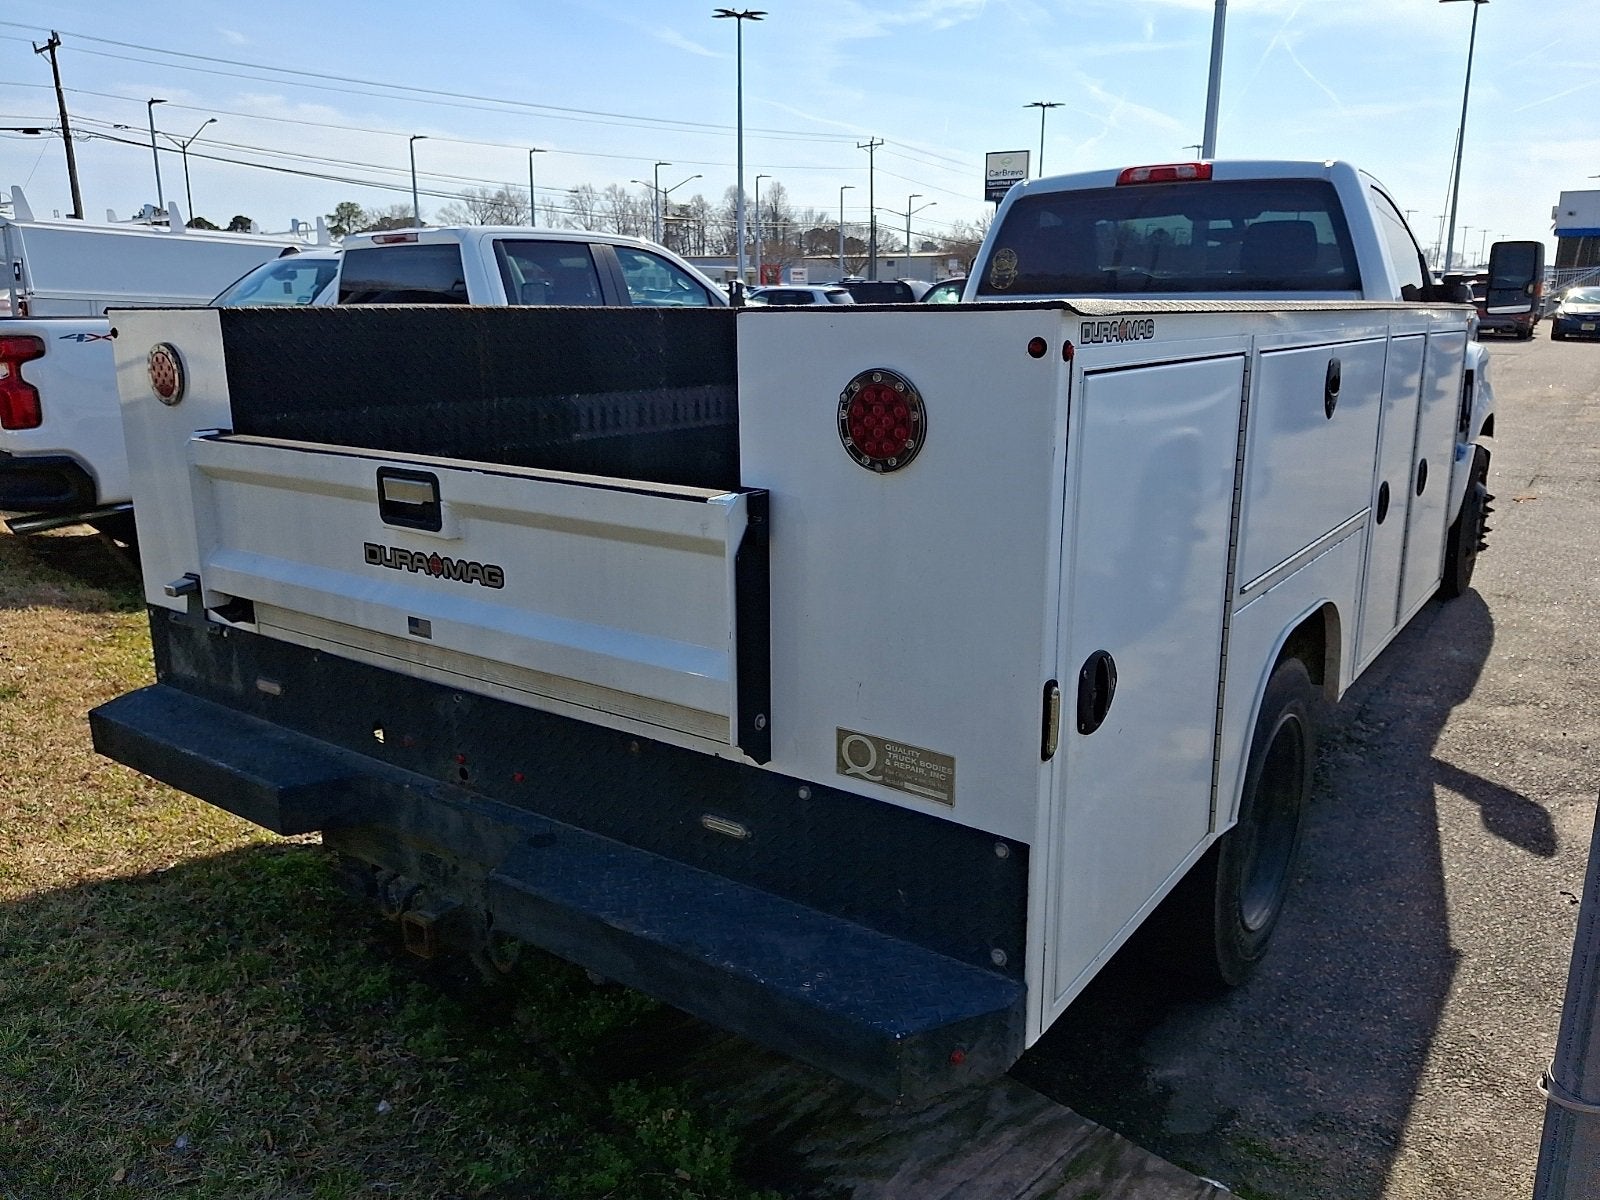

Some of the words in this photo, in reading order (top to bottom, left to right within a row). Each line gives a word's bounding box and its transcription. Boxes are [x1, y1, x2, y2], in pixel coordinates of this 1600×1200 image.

[989, 169, 1024, 177] CarBravo
[885, 743, 920, 758] QUALITY
[885, 758, 891, 766] &
[887, 751, 917, 766] TRUCK
[919, 760, 953, 775] BODIES
